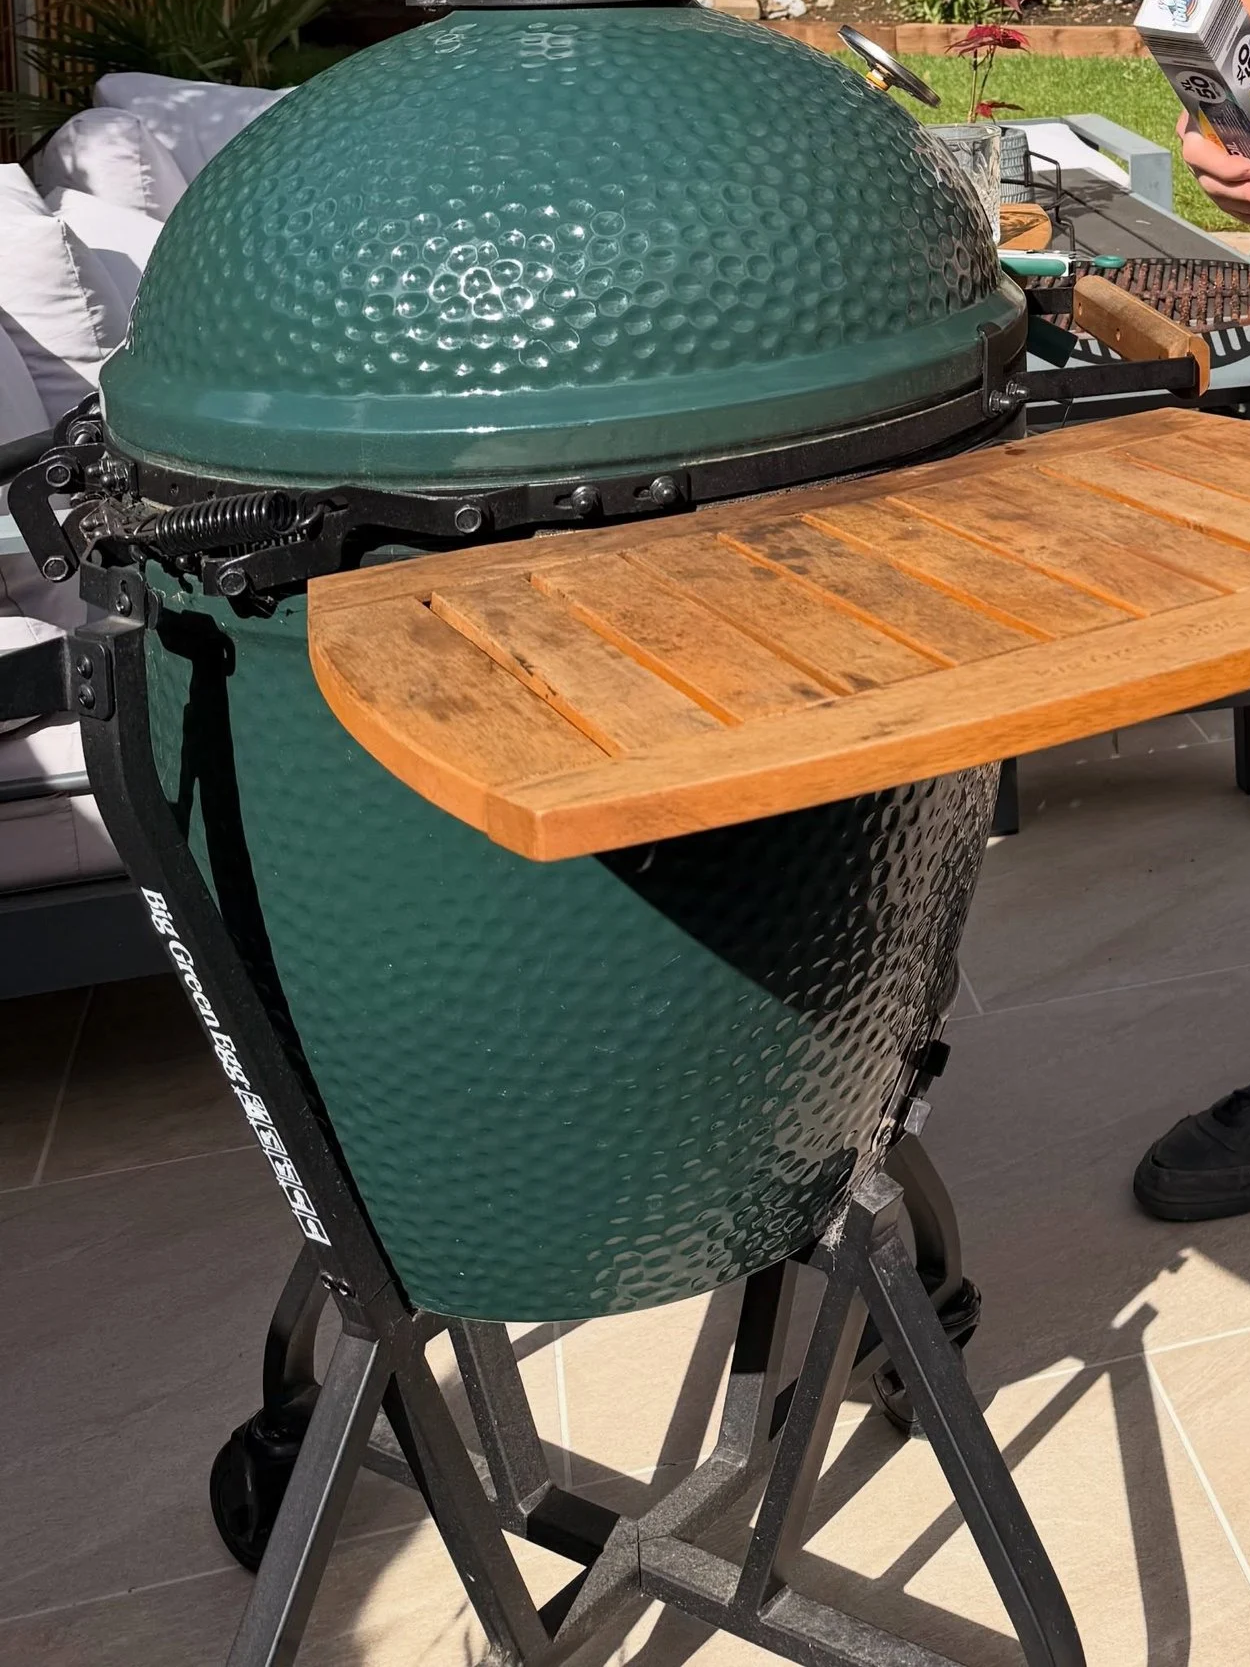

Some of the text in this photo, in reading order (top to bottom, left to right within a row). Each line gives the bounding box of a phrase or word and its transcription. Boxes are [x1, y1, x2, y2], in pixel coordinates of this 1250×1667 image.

[1181, 78, 1195, 93] XL
[1236, 64, 1246, 86] XL
[1189, 75, 1217, 100] 50
[140, 886, 250, 1089] Big Green Egg
